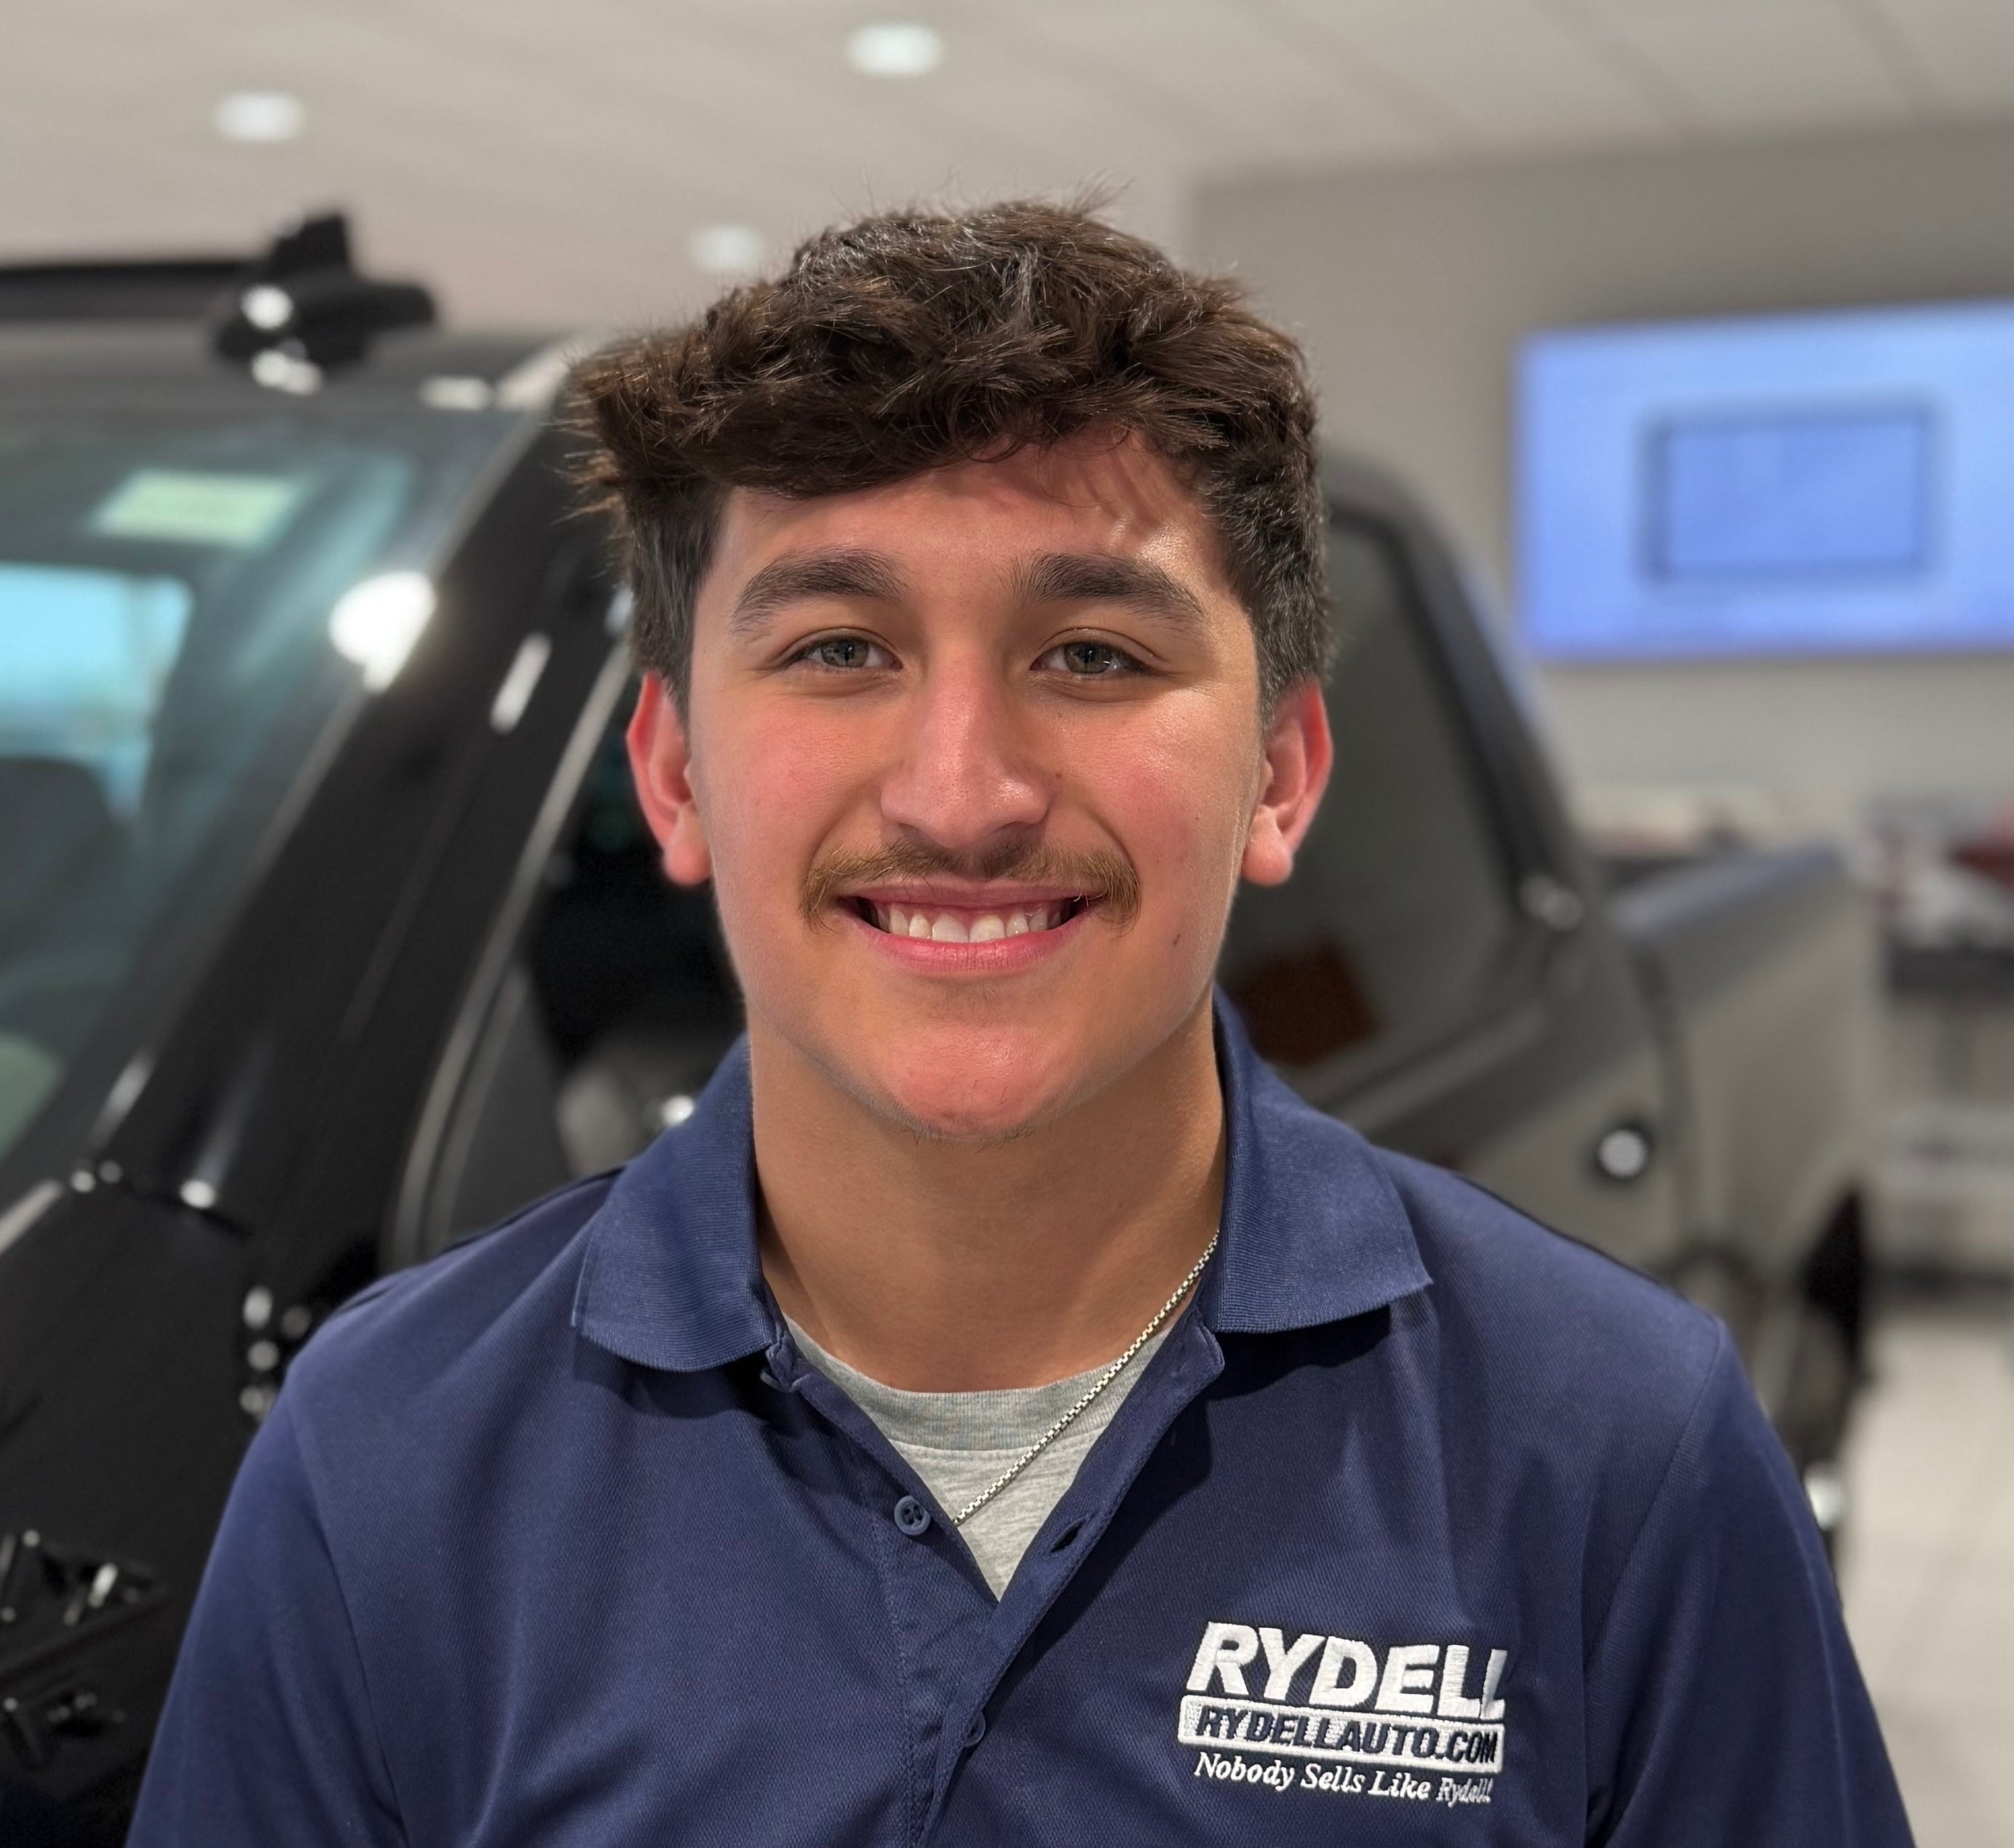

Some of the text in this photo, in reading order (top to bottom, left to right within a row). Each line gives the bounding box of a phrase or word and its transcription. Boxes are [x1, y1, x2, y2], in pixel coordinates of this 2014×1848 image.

[1195, 1705, 1498, 1763] RYDELLAUTO.COM
[1194, 1751, 1295, 1791] Nobody
[1300, 1763, 1365, 1793] Sells
[1368, 1772, 1432, 1799] Like
